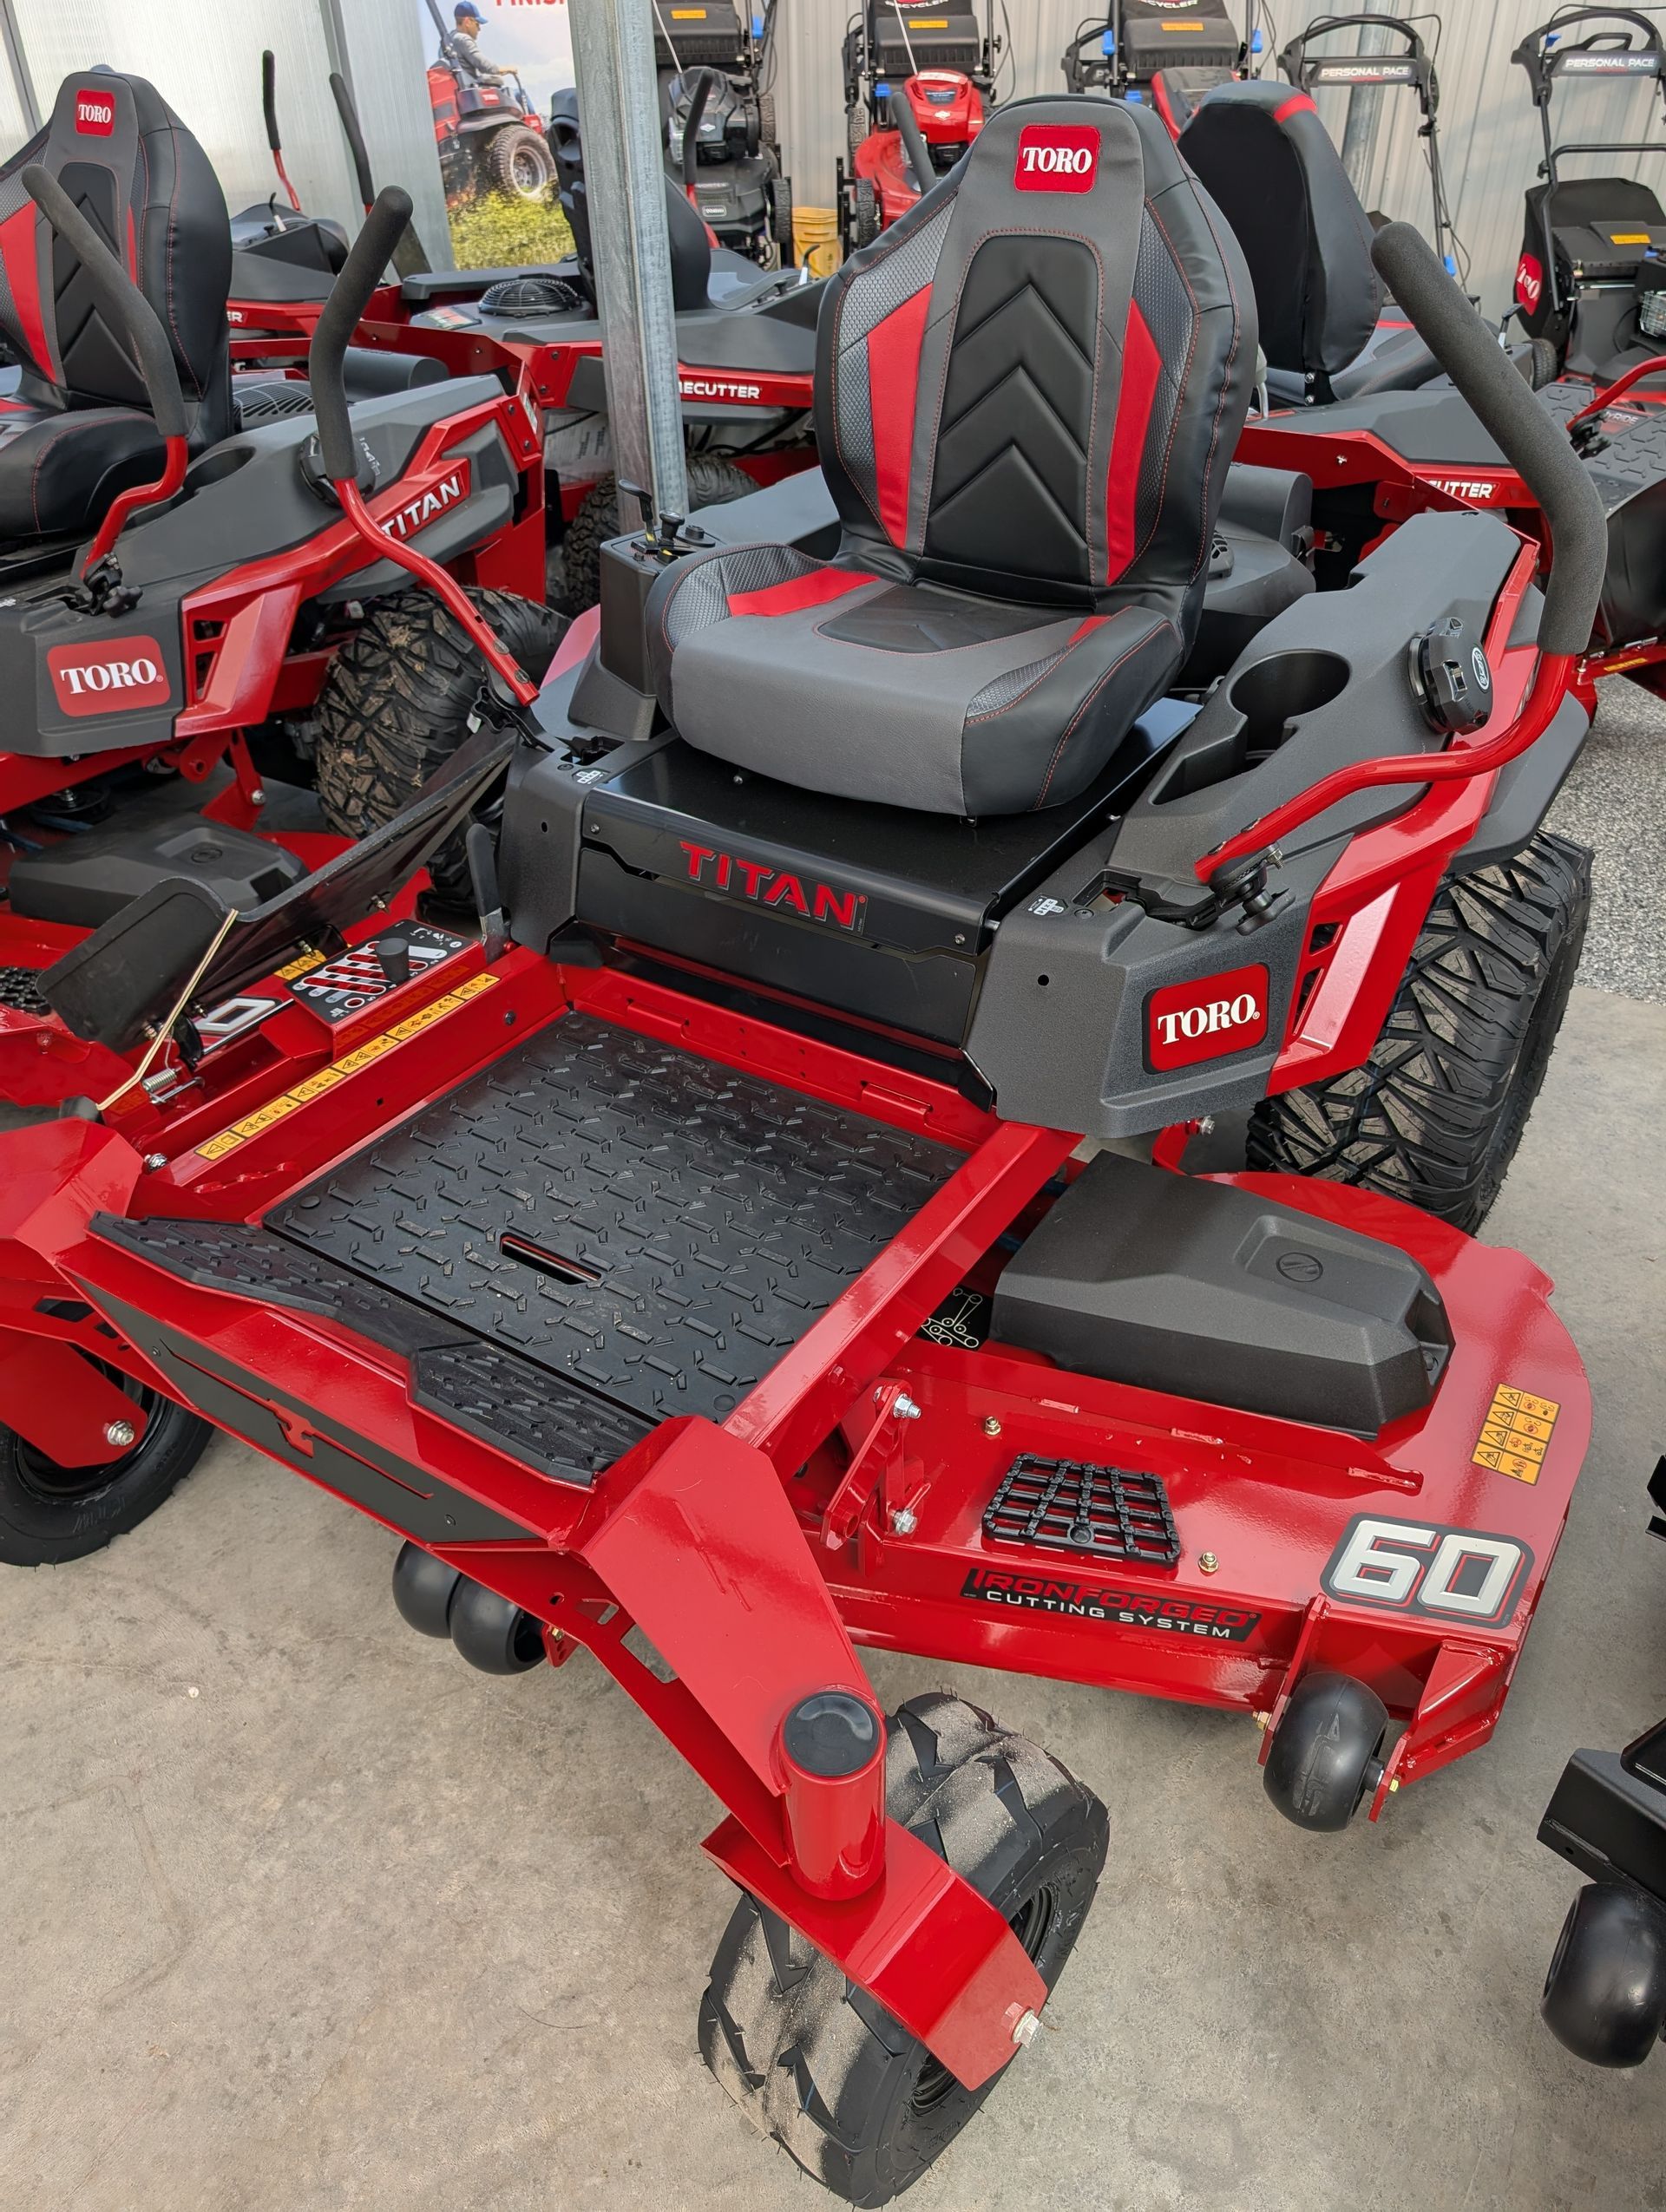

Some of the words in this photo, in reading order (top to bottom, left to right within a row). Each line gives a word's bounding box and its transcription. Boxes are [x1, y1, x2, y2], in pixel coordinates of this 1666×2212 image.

[1322, 67, 1380, 77] PERSONAL
[1382, 66, 1410, 75] PACE
[1565, 59, 1624, 68] PERSONAL
[1628, 58, 1655, 67] PACE
[78, 104, 112, 123] TORO
[1023, 147, 1092, 173] TORO
[381, 476, 460, 537] TITAN
[1329, 1520, 1525, 1620] 60
[986, 1590, 1105, 1619] CUTTING
[1118, 1611, 1231, 1639] SYSTEM
